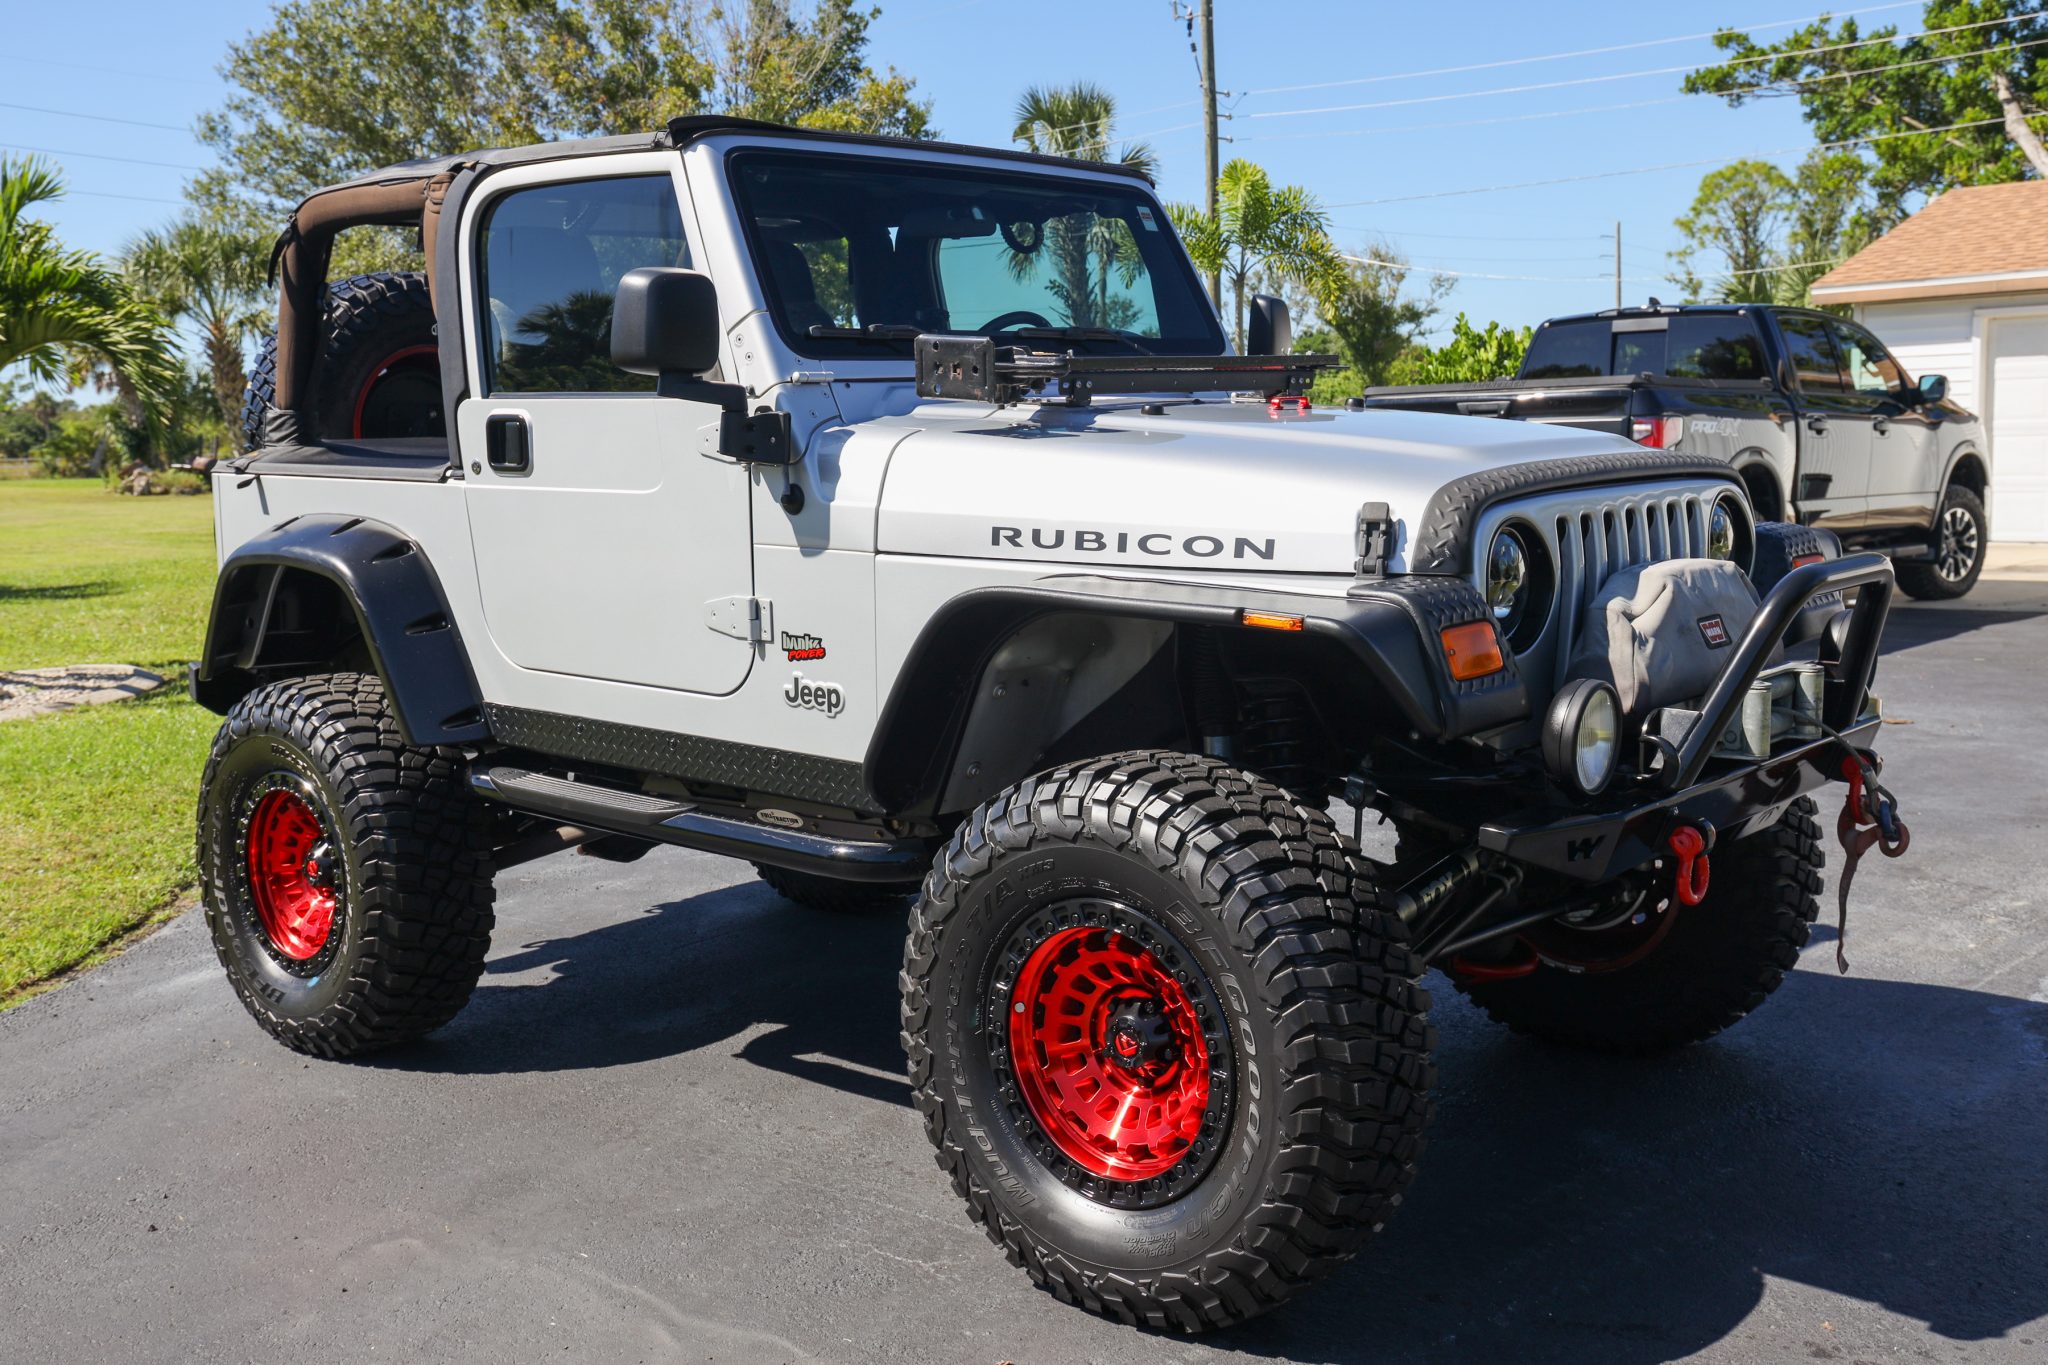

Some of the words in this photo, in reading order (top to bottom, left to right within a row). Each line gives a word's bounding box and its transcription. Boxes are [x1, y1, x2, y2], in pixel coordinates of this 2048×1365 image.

[991, 525, 1276, 561] RUBICON
[788, 647, 826, 661] POWER
[784, 677, 841, 714] Jeep
